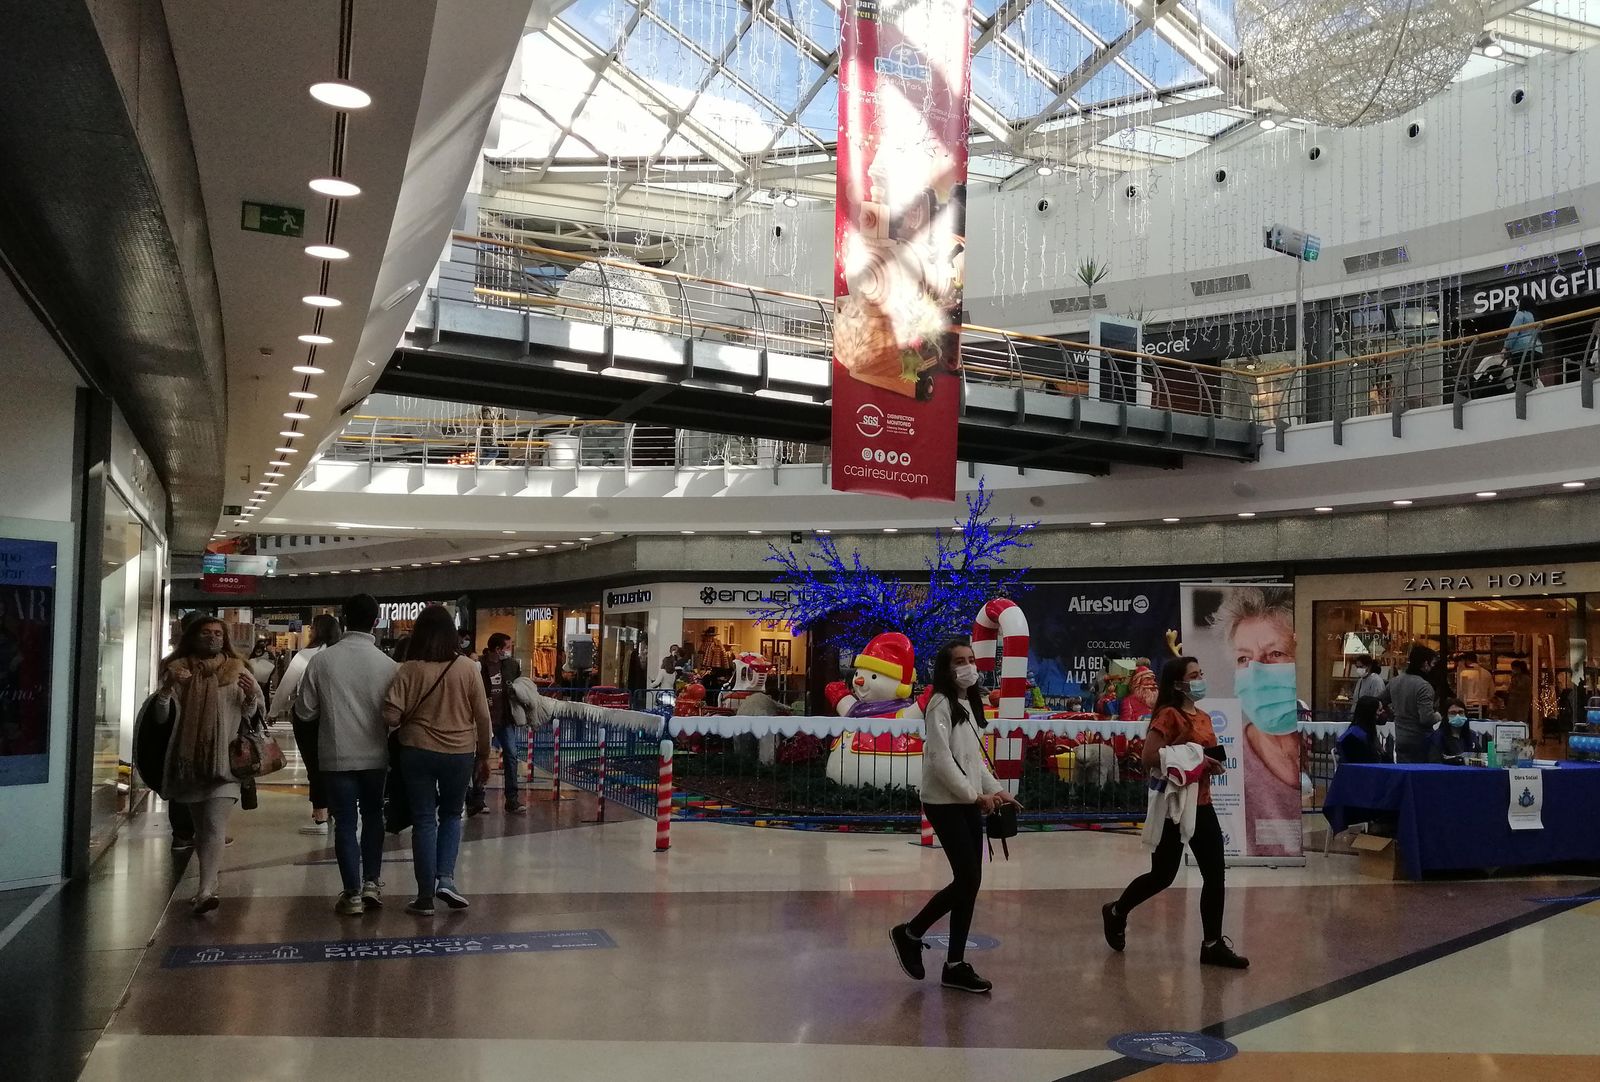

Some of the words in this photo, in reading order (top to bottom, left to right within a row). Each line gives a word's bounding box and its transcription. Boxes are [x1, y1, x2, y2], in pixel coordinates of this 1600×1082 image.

[1473, 267, 1600, 314] SPRINGFI
[863, 415, 879, 427] SGS
[843, 464, 929, 485] ccairesur.com
[1403, 576, 1473, 591] ZARA
[1487, 571, 1566, 588] HOME
[719, 586, 816, 602] encuent
[0, 586, 46, 621] AR
[1068, 595, 1132, 612] AireSur
[1074, 656, 1086, 670] LA
[1075, 670, 1087, 684] LA
[1218, 735, 1235, 744] Sur
[1222, 757, 1237, 769] ALO
[325, 940, 482, 952] DISTANCIA
